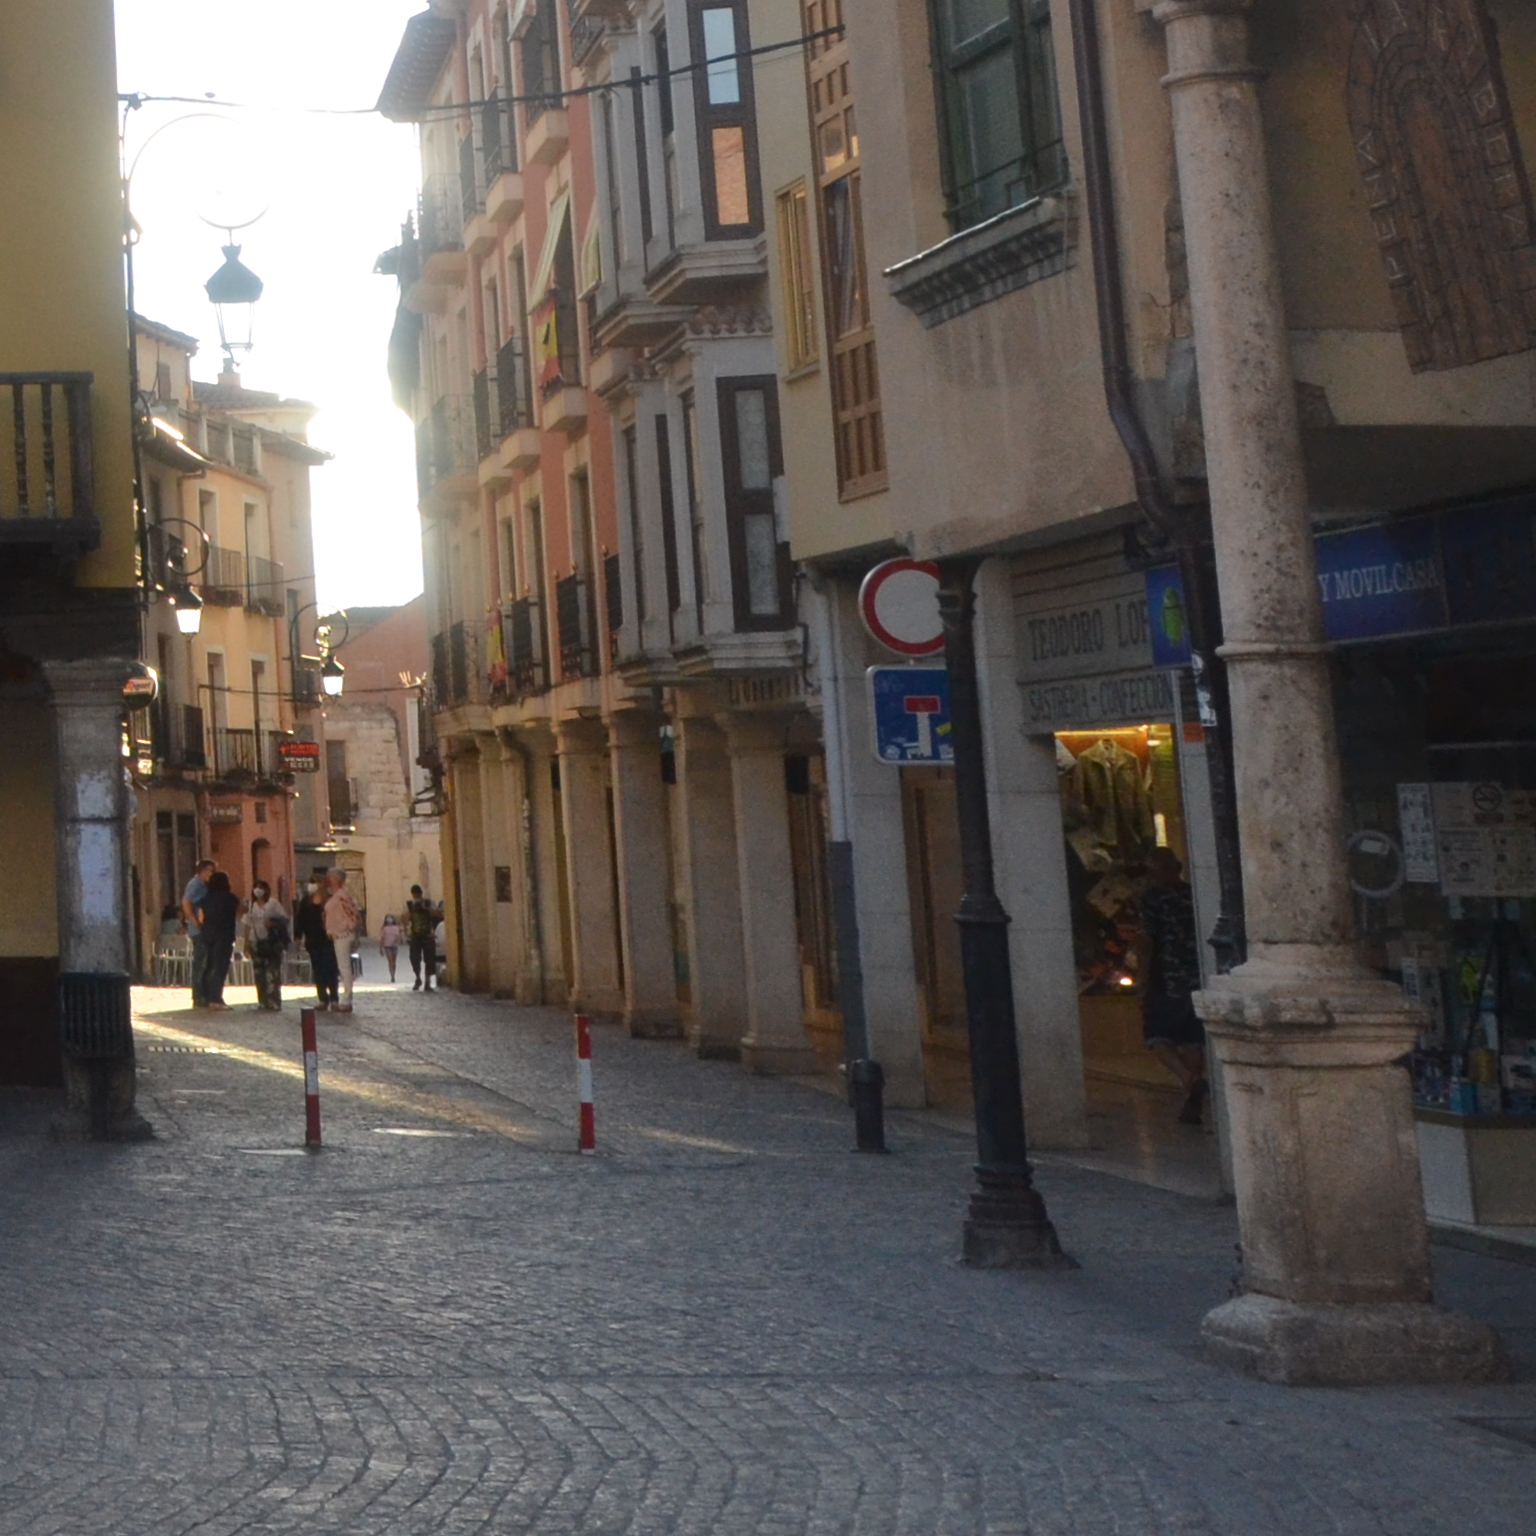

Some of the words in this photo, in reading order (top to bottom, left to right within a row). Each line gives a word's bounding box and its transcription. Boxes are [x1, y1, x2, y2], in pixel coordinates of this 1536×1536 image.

[1317, 572, 1330, 602] Y
[1334, 557, 1441, 600] MOVILCASA
[1028, 607, 1104, 662] TEODORO
